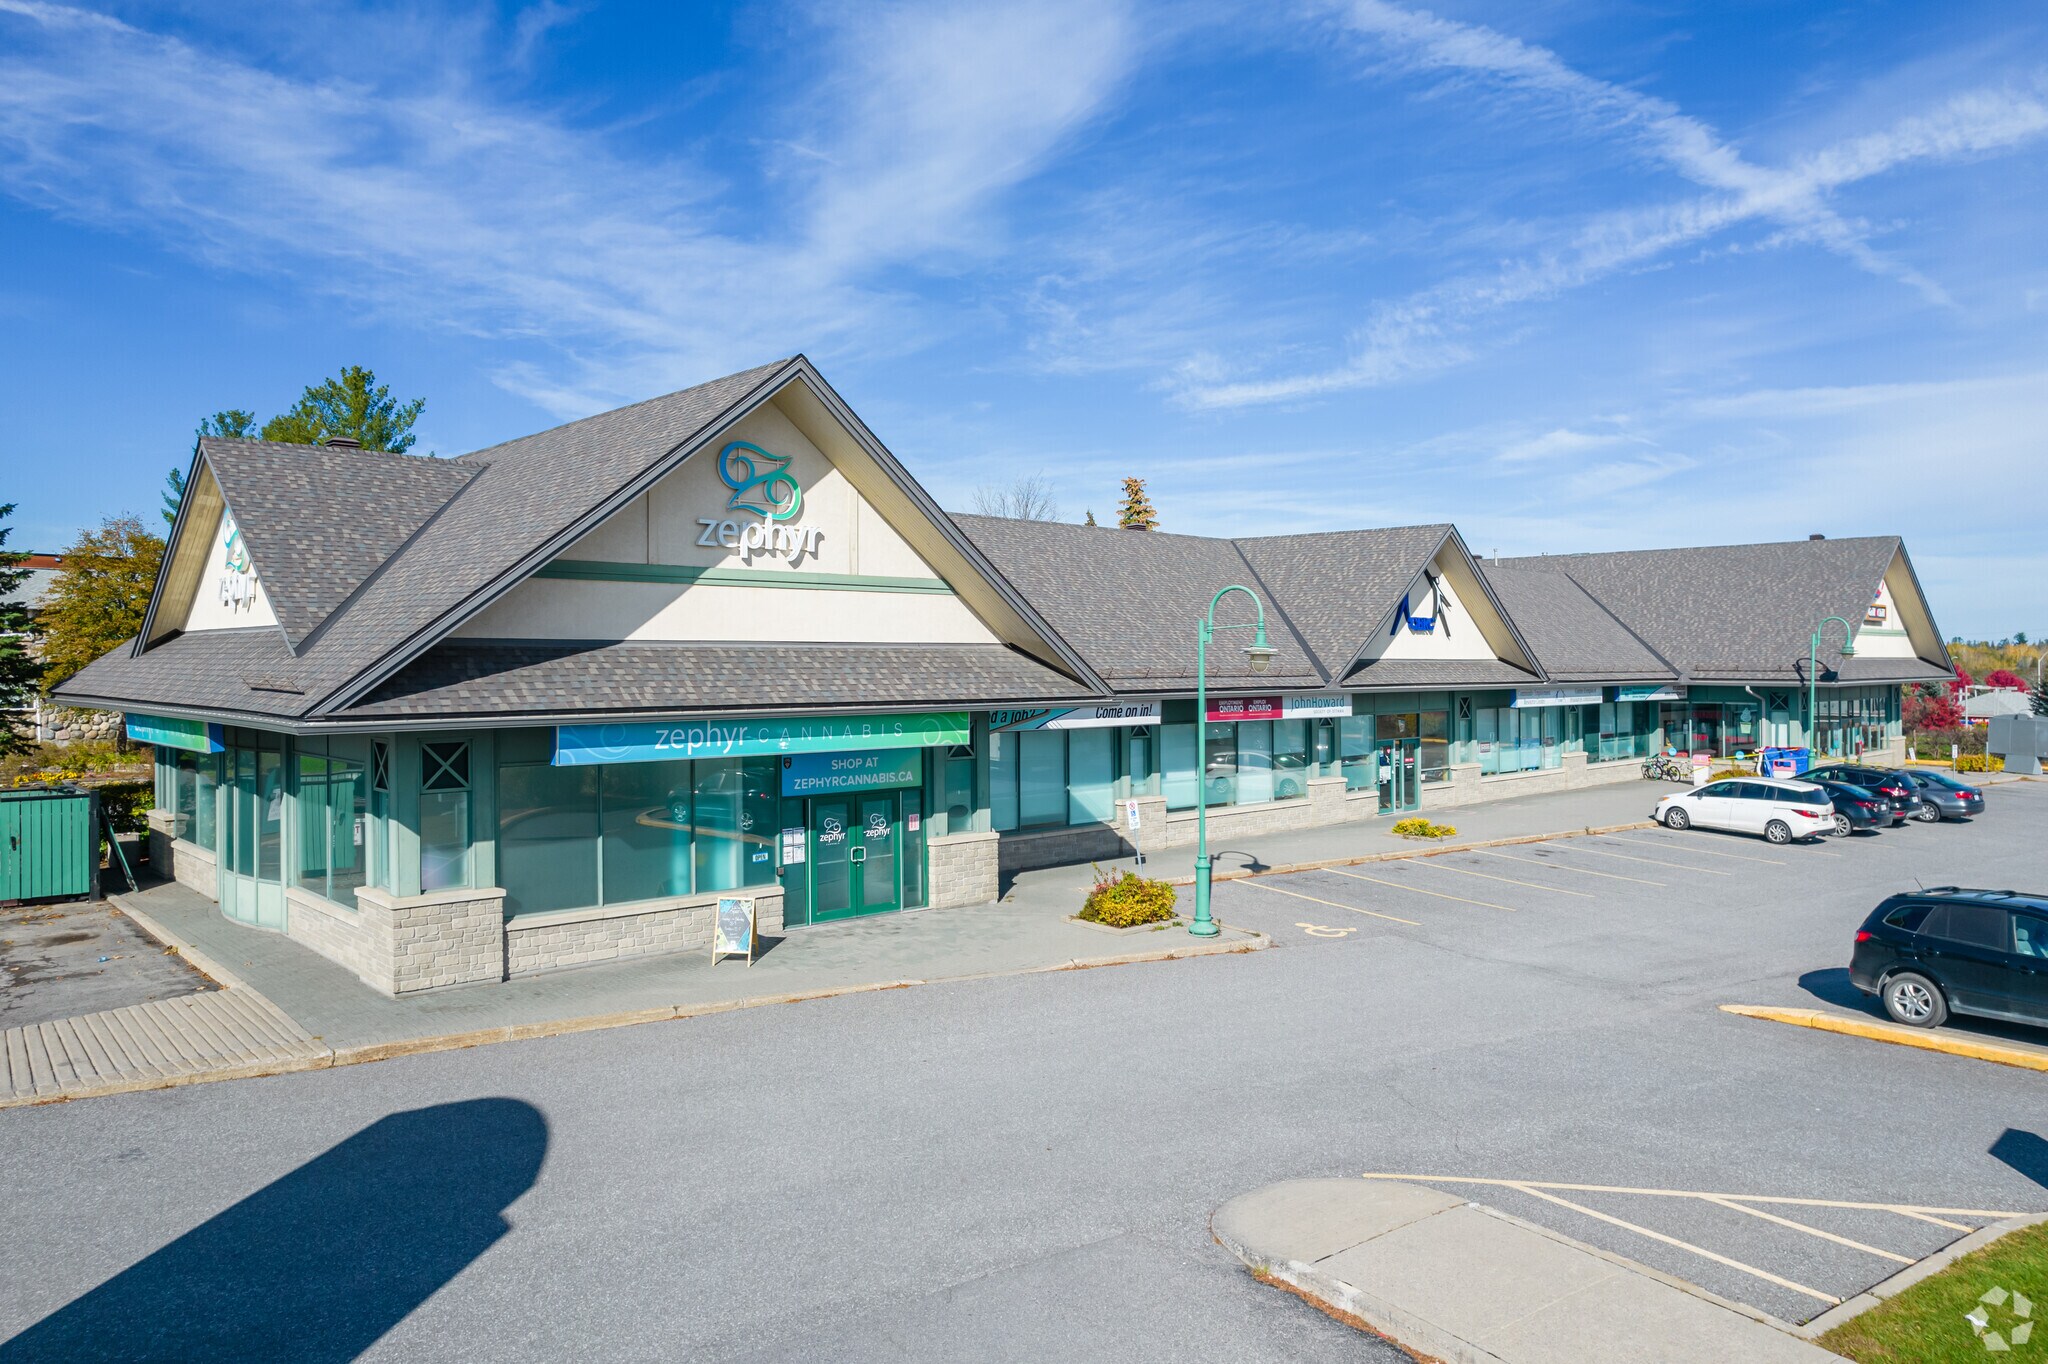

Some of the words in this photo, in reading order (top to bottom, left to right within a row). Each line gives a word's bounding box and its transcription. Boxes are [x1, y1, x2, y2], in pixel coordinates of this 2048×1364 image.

[696, 512, 821, 562] zephyr
[1219, 705, 1244, 713] ONTARIO
[1248, 704, 1272, 712] ONTARIO
[1291, 696, 1345, 712] JohnHoward
[1000, 711, 1007, 723] a
[1095, 707, 1122, 719] Come
[1125, 707, 1137, 717] on
[1139, 703, 1153, 716] in!
[654, 725, 748, 755] zephyr
[758, 722, 903, 743] CANNABIS
[831, 758, 862, 770] SHOP
[865, 757, 879, 768] AT
[793, 771, 914, 790] ZEPHYRCANNABIS.CA
[819, 831, 847, 843] zephyr
[865, 827, 891, 839] zephyr
